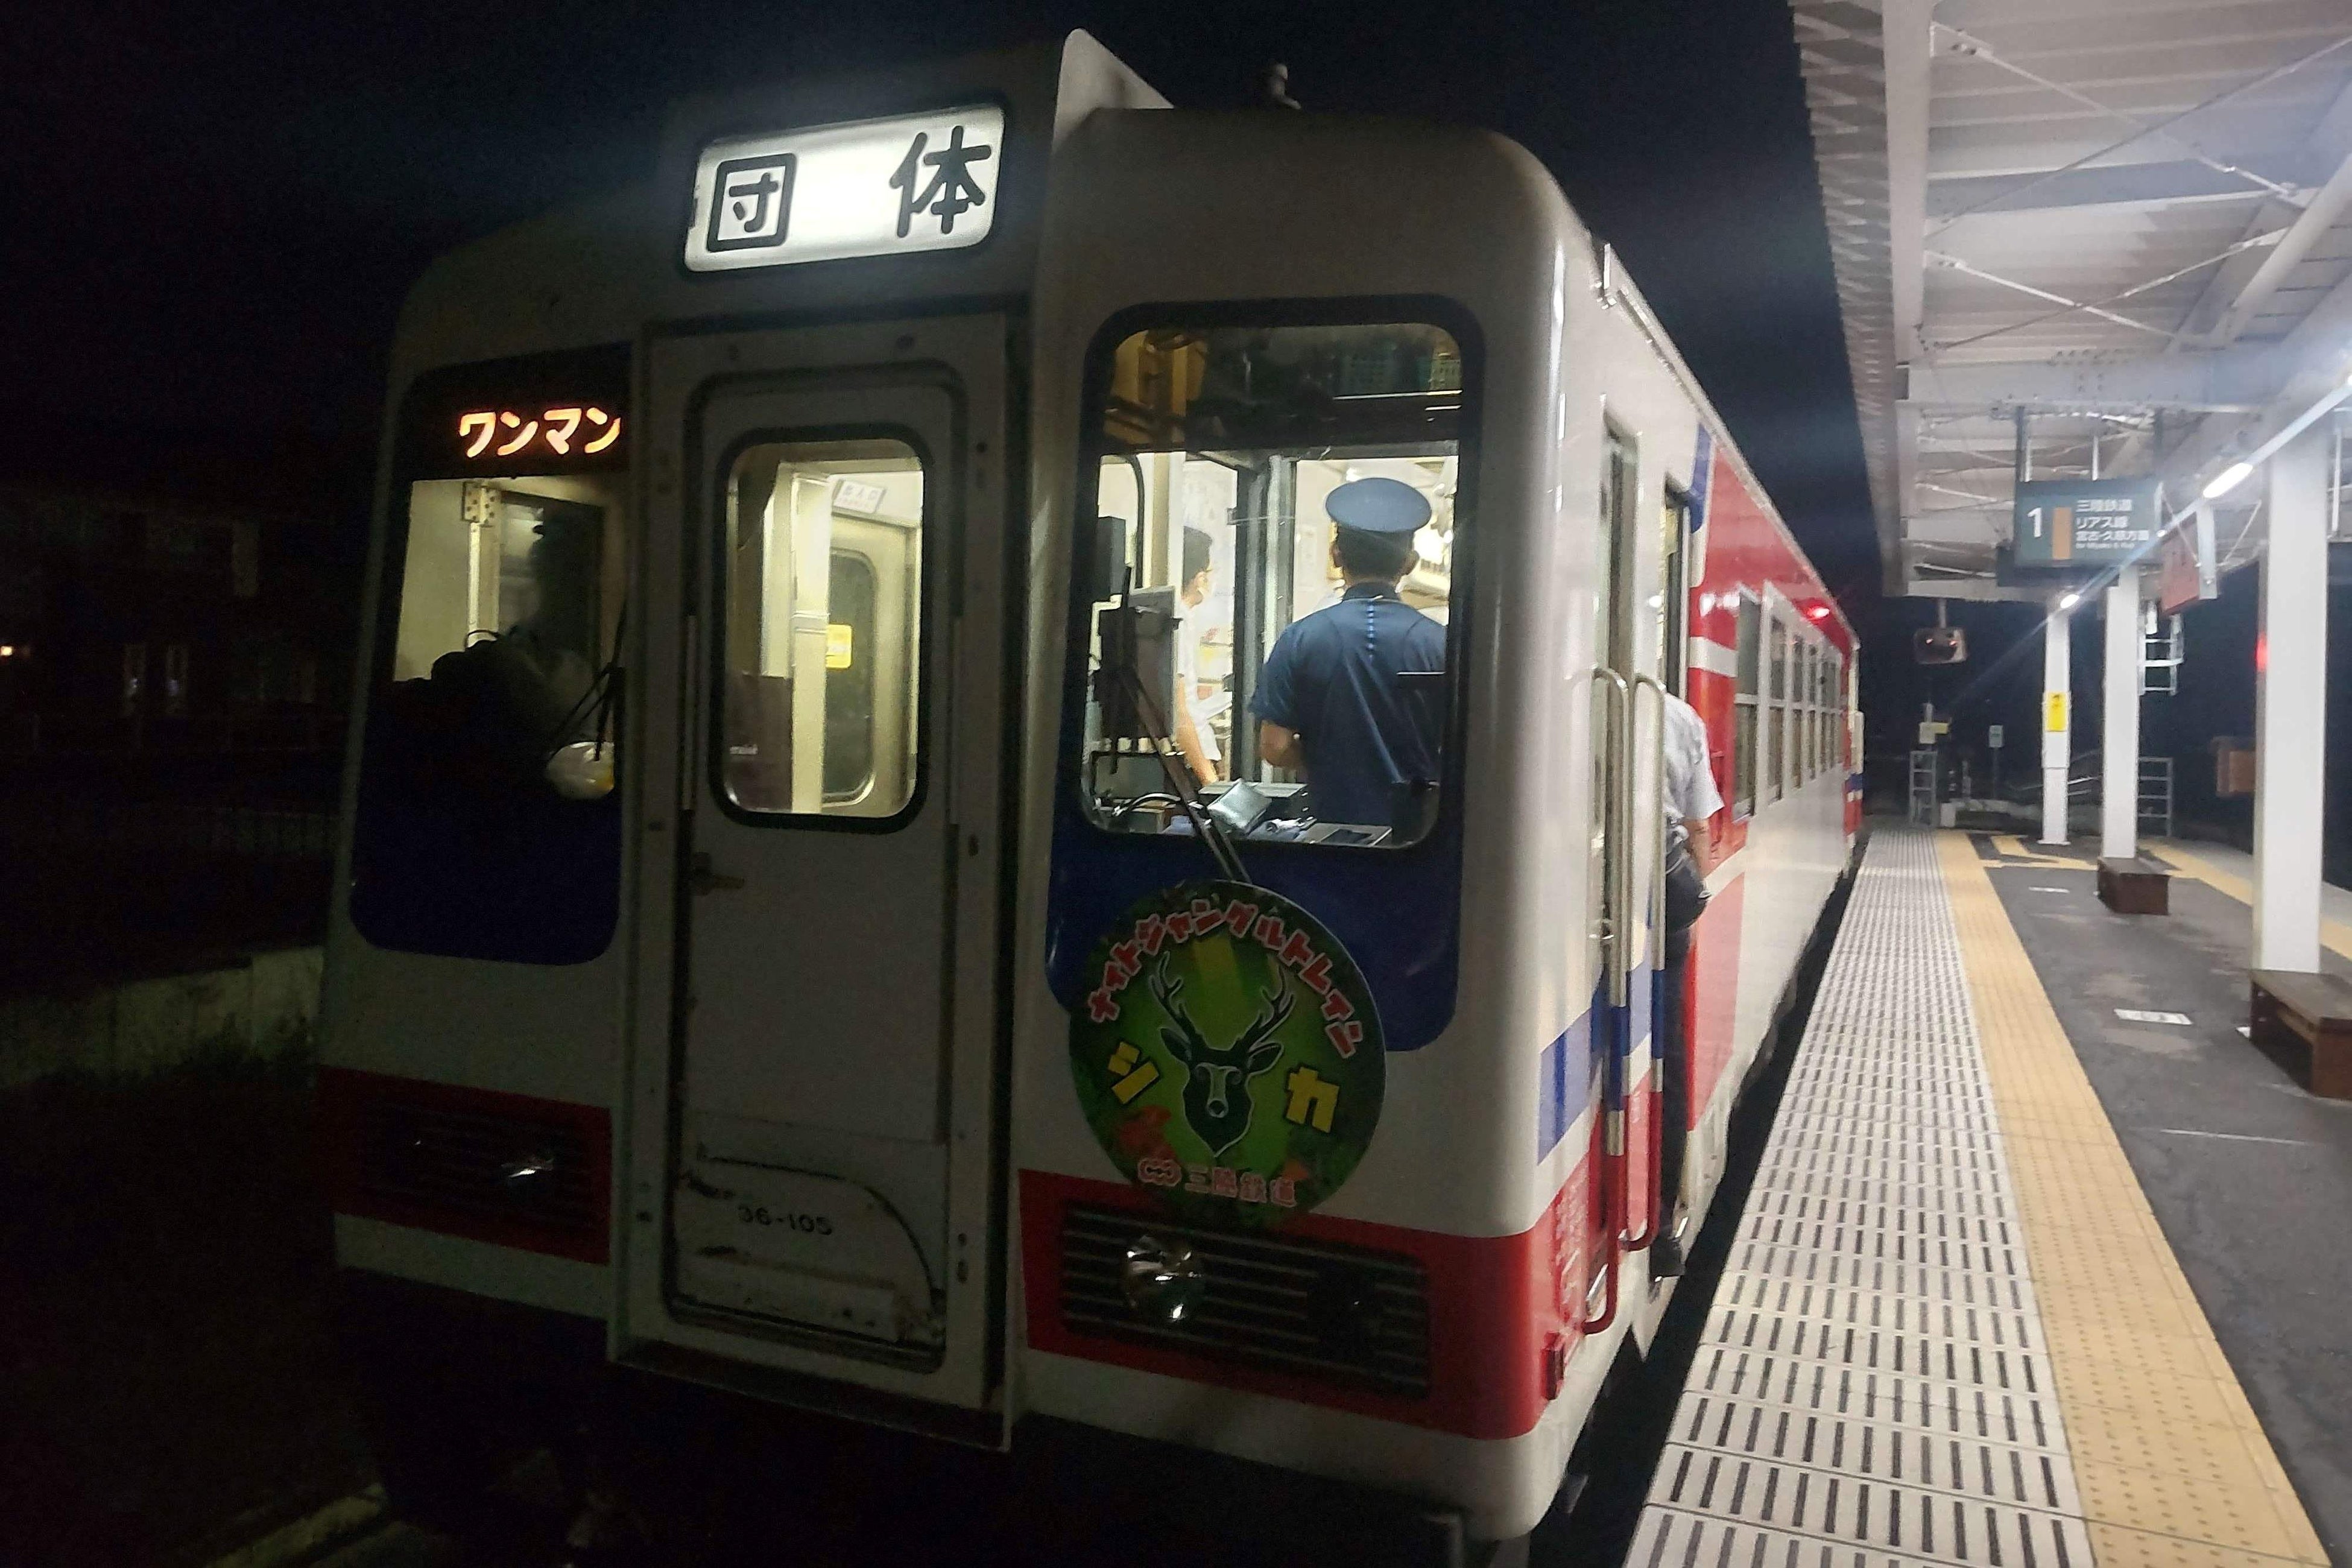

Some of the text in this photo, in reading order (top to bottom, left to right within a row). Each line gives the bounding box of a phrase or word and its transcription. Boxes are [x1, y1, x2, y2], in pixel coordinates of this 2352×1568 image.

[706, 125, 991, 251] 団体
[459, 407, 621, 458] ワンマン
[2027, 507, 2043, 538] 1
[738, 1206, 832, 1235] 36-105
